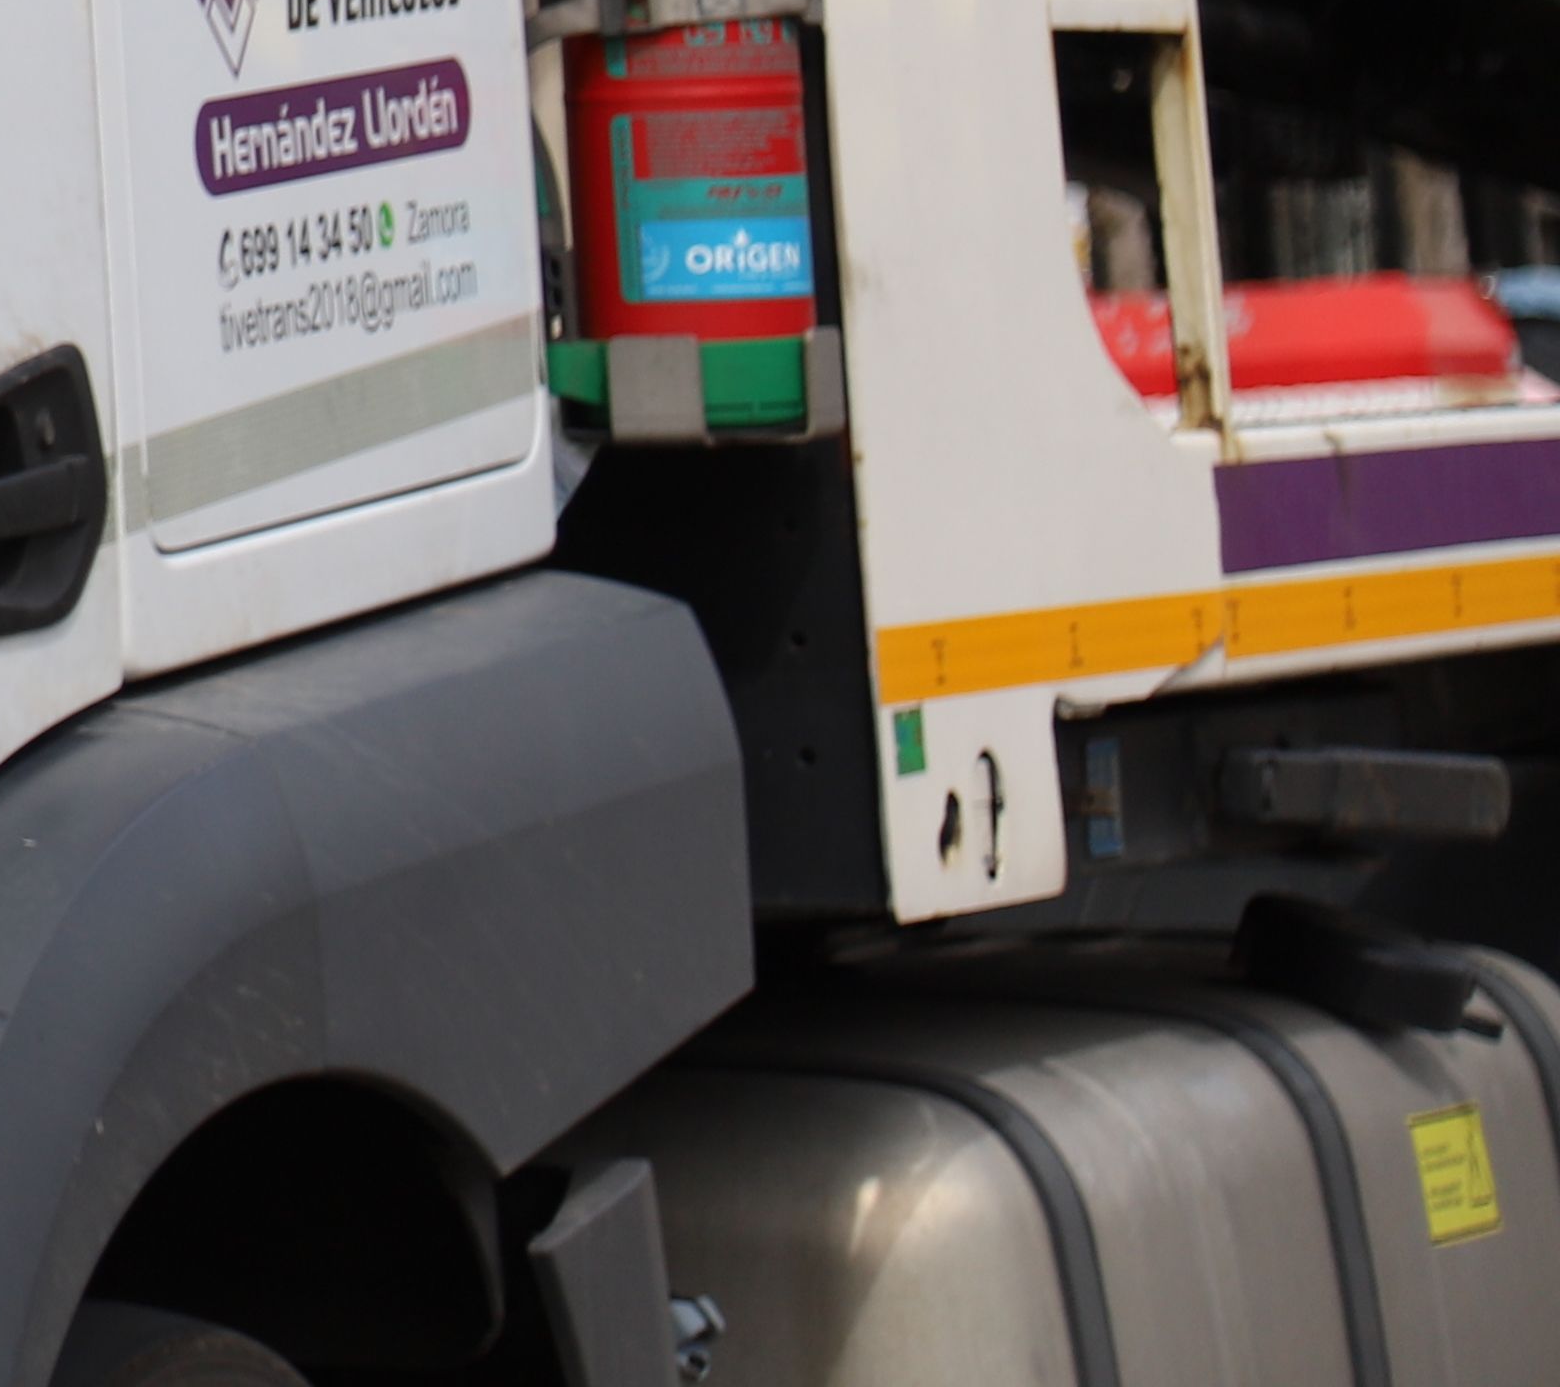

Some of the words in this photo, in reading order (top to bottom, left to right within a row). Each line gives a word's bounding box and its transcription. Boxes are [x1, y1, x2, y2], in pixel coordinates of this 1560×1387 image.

[209, 96, 359, 180] Hernández
[240, 223, 280, 277] 699
[286, 215, 312, 269] 14
[318, 208, 343, 262] 34
[349, 203, 373, 255] 50
[406, 199, 471, 245] Zamora
[219, 259, 478, 353] tivetrans2018@gmail.com
